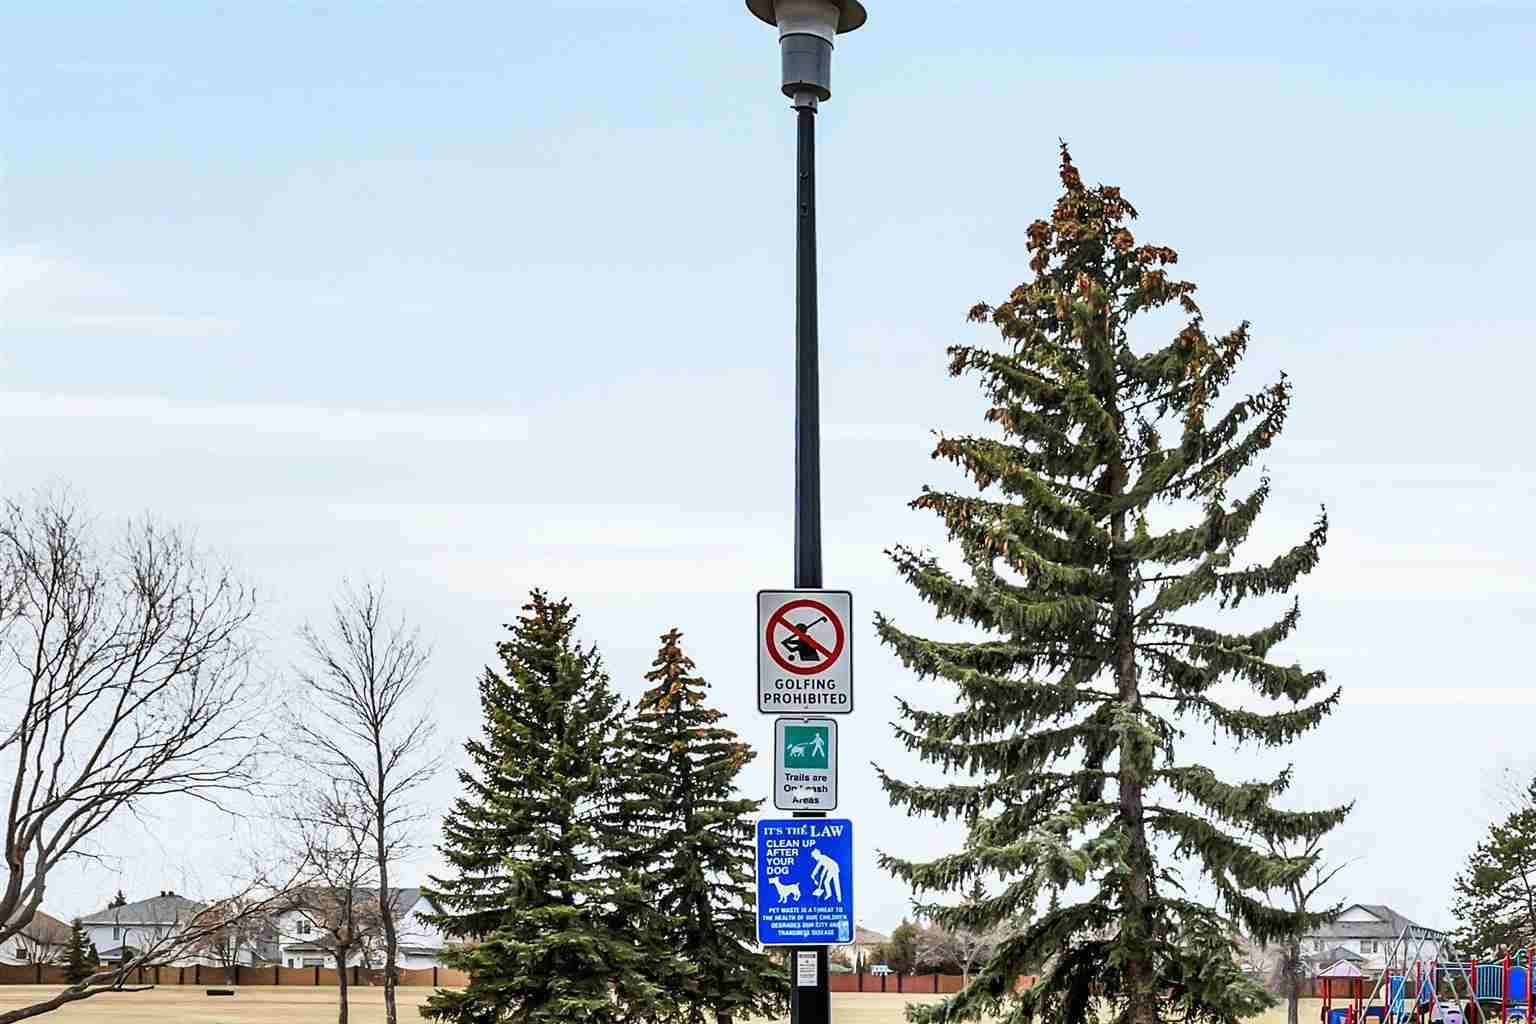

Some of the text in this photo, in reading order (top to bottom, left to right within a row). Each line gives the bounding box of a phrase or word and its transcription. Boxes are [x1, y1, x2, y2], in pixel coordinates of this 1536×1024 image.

[775, 679, 836, 690] GOLFING
[763, 693, 848, 705] PROHIBITED
[785, 773, 810, 782] Trails
[799, 784, 828, 793] ash
[792, 796, 820, 804] Areas
[763, 825, 844, 838] IT'S THE LAW
[766, 839, 816, 848] CLEAN UP
[766, 848, 799, 857] AFTER
[766, 857, 795, 866] YOUR
[766, 866, 790, 875] DOG
